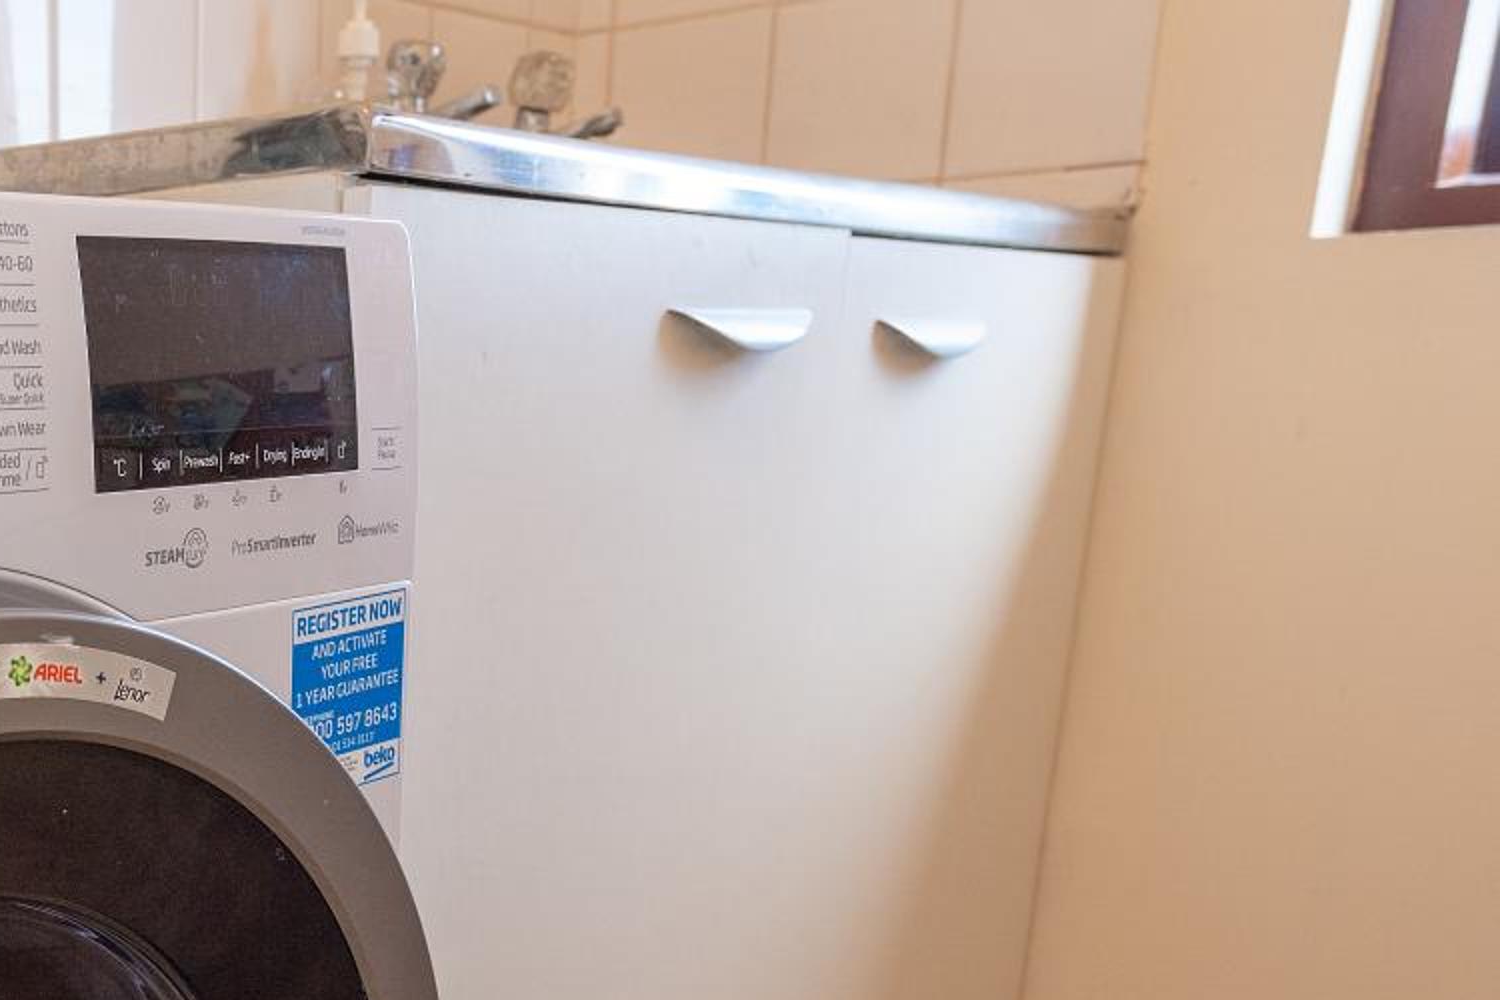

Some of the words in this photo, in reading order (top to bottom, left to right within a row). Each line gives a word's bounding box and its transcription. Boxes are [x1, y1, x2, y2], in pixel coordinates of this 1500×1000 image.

[11, 339, 43, 355] Wash
[13, 373, 43, 390] Quick
[18, 421, 46, 436] Wear
[151, 456, 171, 474] Spin
[145, 547, 185, 567] STEAM
[297, 603, 366, 637] REGISTER
[369, 597, 402, 622] NOW
[311, 641, 336, 661] AND
[337, 629, 387, 654] ACTIVATE
[321, 660, 351, 680] YOUR
[352, 652, 379, 673] FREE
[33, 662, 82, 684] ARIEL
[113, 678, 151, 703] Lenor
[304, 684, 336, 706] YEAR
[336, 668, 400, 699] GUARANTEE
[337, 712, 361, 735] 597
[364, 702, 397, 727] 8643
[364, 746, 396, 768] beko
